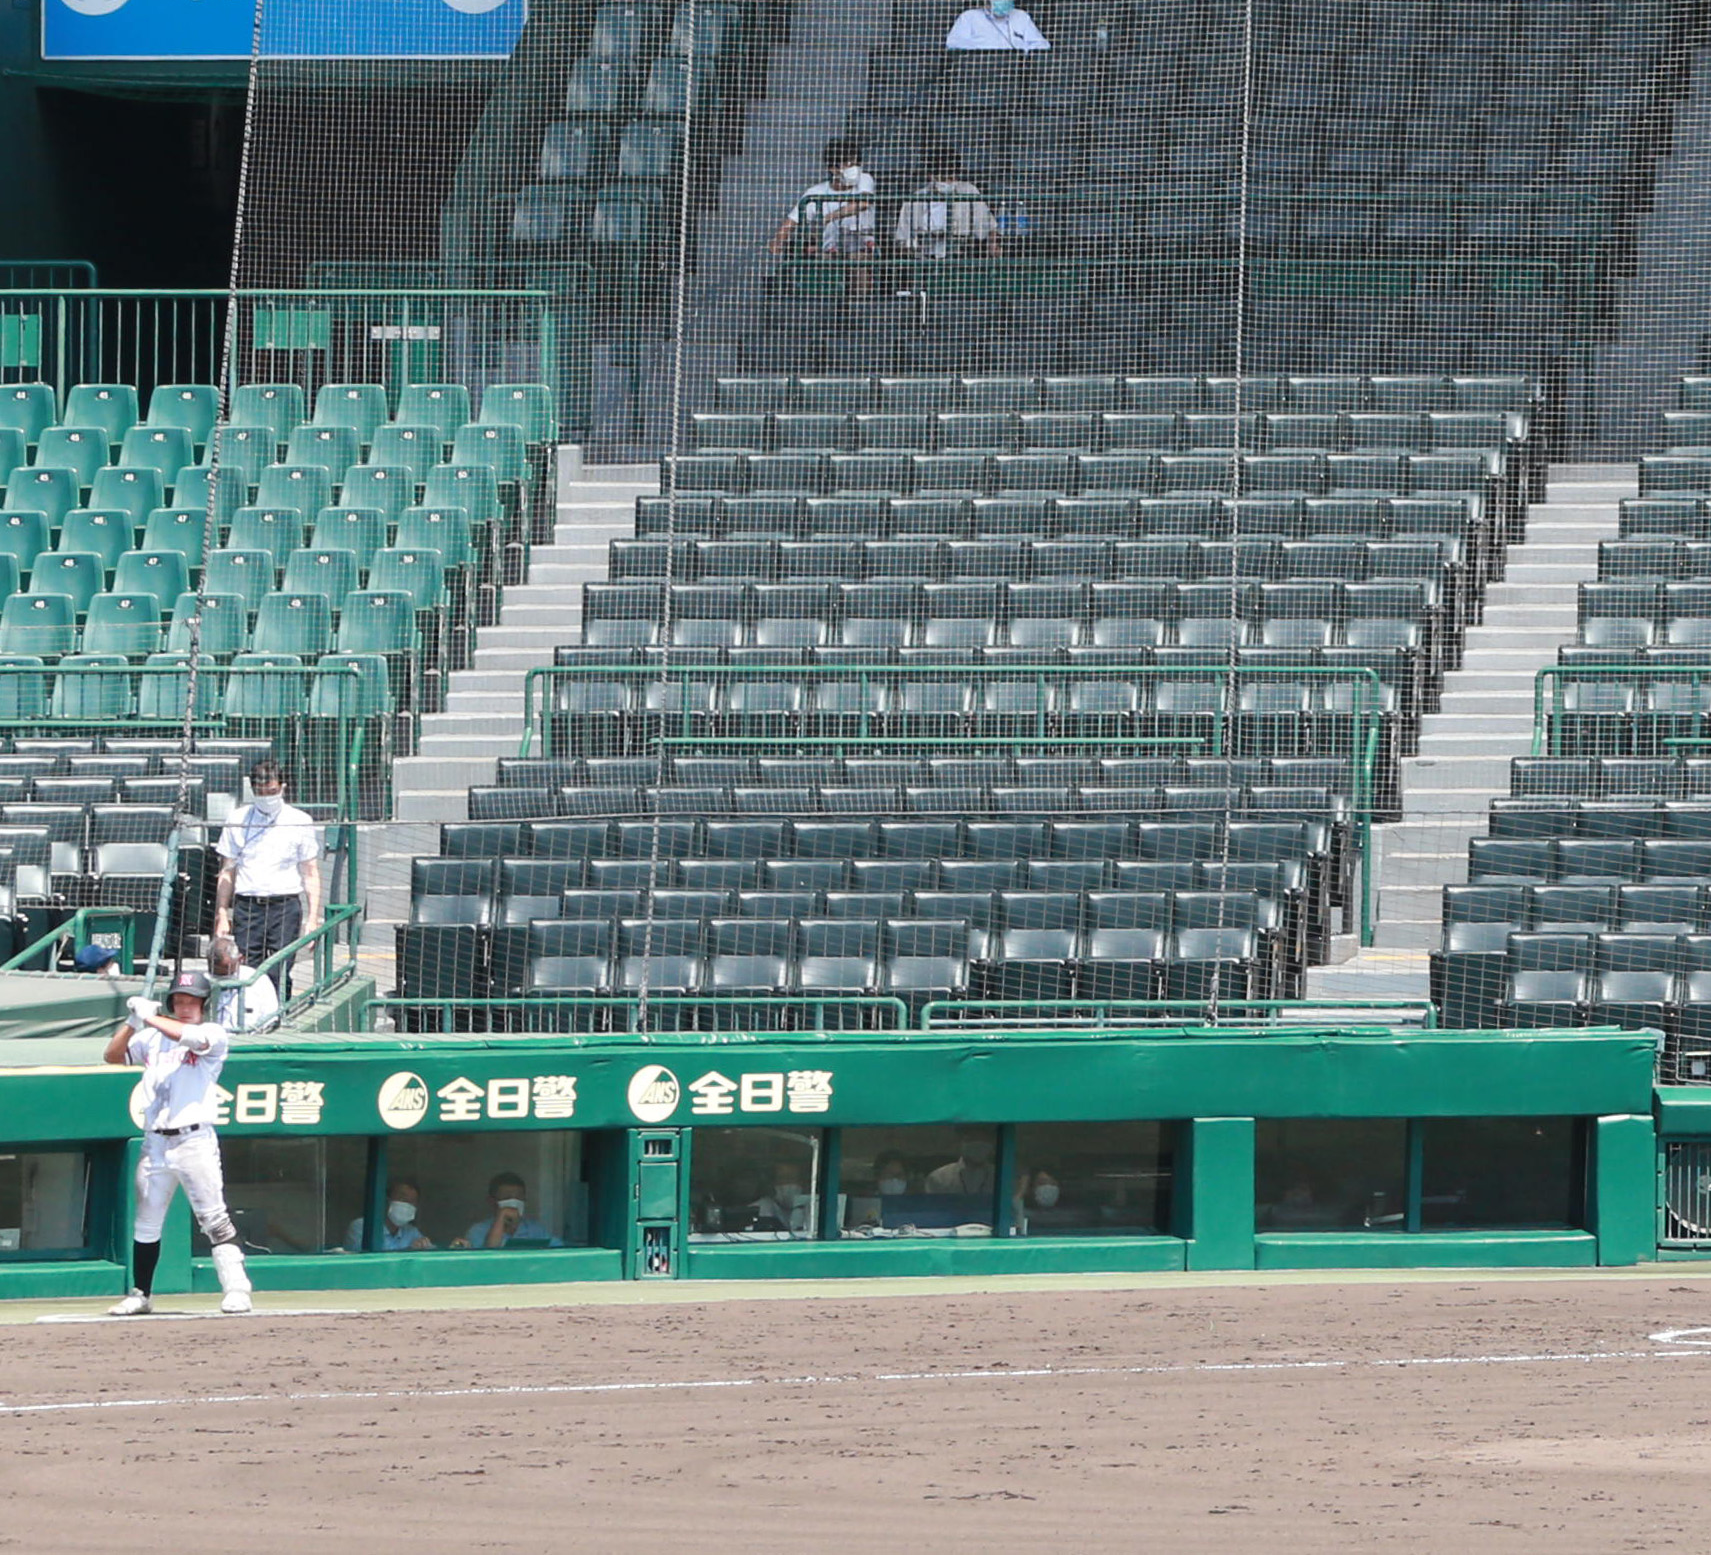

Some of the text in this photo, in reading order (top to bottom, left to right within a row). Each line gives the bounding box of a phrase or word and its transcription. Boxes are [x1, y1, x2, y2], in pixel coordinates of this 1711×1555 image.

[436, 1075, 578, 1122] 全日警
[688, 1069, 834, 1115] 全日警
